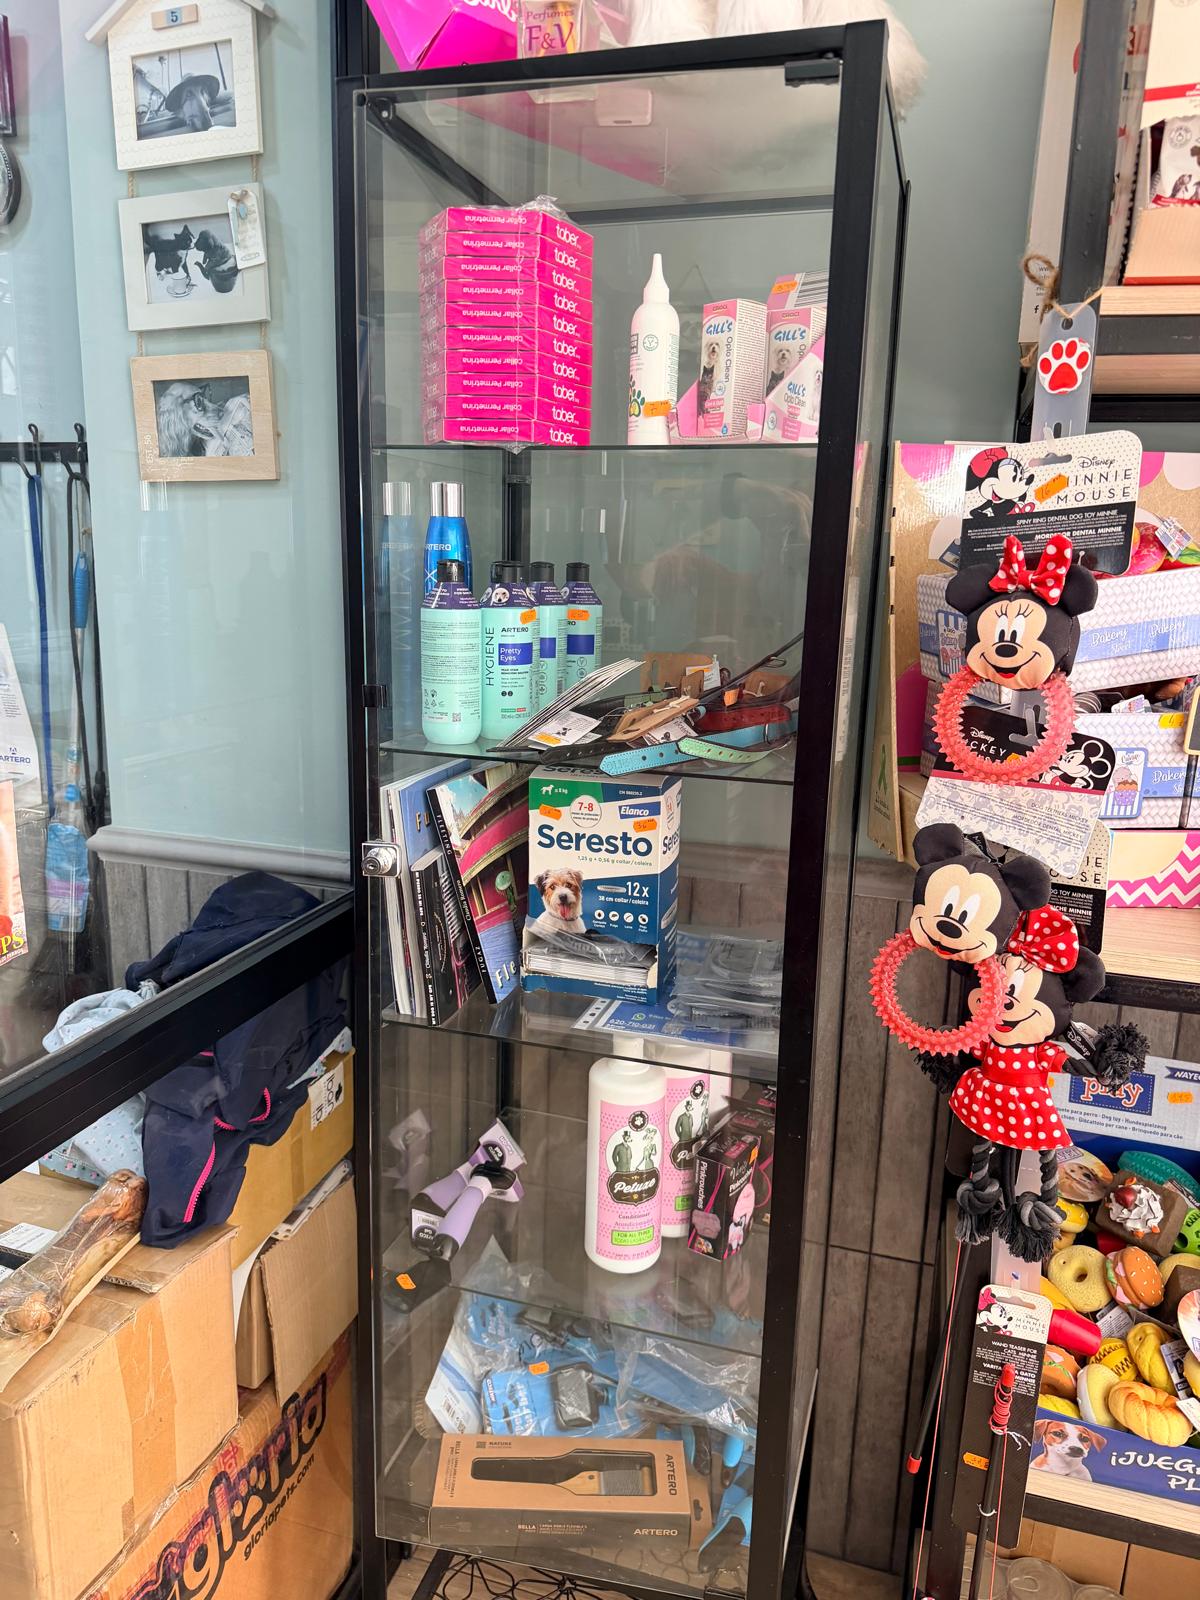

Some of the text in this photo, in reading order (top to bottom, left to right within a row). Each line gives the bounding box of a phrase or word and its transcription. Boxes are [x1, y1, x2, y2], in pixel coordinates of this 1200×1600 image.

[170, 10, 179, 23] 5
[526, 9, 574, 20] Perfumes
[525, 21, 574, 51] F&V
[465, 215, 527, 224] Collar Permetrina
[463, 240, 525, 249] Collar Permetrina
[461, 264, 522, 272] Collar Permetrina
[463, 287, 524, 295] Collar Permetrina
[462, 310, 524, 318] Collar Permetrina
[706, 320, 733, 336] GILL'S
[463, 334, 524, 342] Collar Permetrina
[774, 328, 807, 342] GILL'S
[463, 357, 523, 365] Collar Permetrina
[725, 336, 734, 383] Opto Clean
[463, 379, 501, 387] Permetrina
[500, 425, 520, 433] Collar
[1077, 456, 1115, 468] Disney
[1067, 469, 1132, 487] INNIE
[1056, 487, 1131, 505] MOUSE
[1096, 509, 1118, 517] MINNIE
[1072, 526, 1122, 537] DENTAL MINNIE
[1091, 628, 1129, 647] Bakery
[485, 626, 495, 687] HYGIENE
[500, 647, 522, 656] Pretty
[970, 726, 995, 744] Disney
[578, 801, 594, 812] 7-8
[620, 806, 650, 816] Elanco
[1069, 814, 1089, 823] MICKEY
[1042, 823, 1062, 833] DENTAL
[436, 814, 452, 855] FLEETING
[537, 824, 653, 857] Seresto
[626, 881, 639, 897] 12
[1072, 892, 1094, 900] MINNIE
[463, 900, 471, 921] Claudia
[1069, 907, 1093, 916] MINNIE
[475, 945, 487, 973] FUGAZ
[1067, 1026, 1091, 1056] Disney
[1071, 1108, 1083, 1116] para
[1102, 1113, 1112, 1121] Dog
[1112, 1115, 1121, 1123] toy
[1105, 1121, 1114, 1129] per
[1131, 1126, 1160, 1136] Brinquedo
[1160, 1131, 1173, 1139] para
[697, 1160, 708, 1209] Pinkrouches
[1015, 1323, 1046, 1334] MOUSE
[1016, 1317, 1046, 1329] MINNIE
[991, 1340, 1009, 1348] WAND
[1009, 1344, 1027, 1352] TEASER
[1018, 1351, 1037, 1359] MINNIE
[982, 1362, 1036, 1378] VARITA GATO
[665, 1453, 678, 1496] ARTERO
[243, 1453, 315, 1561] gloriapets.com
[633, 1528, 678, 1536] ARTERO
